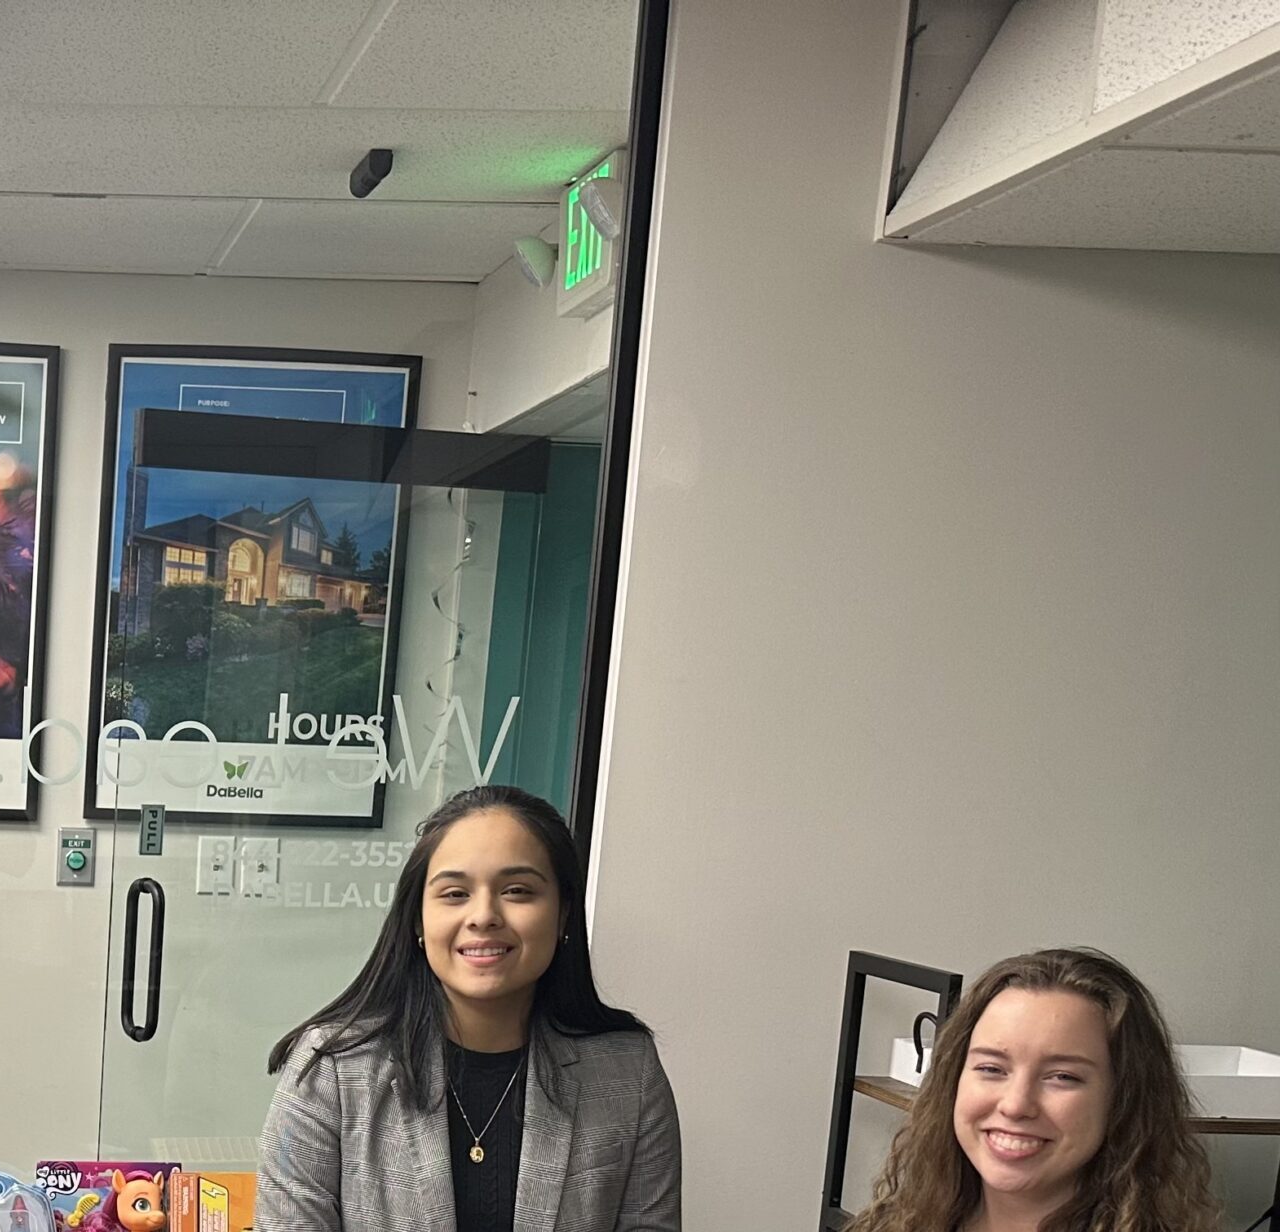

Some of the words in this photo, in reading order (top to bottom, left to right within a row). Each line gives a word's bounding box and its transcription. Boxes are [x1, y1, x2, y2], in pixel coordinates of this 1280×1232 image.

[267, 711, 384, 742] HOURS
[206, 784, 264, 799] DaBella
[146, 809, 158, 852] PULL
[68, 840, 85, 848] EXIT
